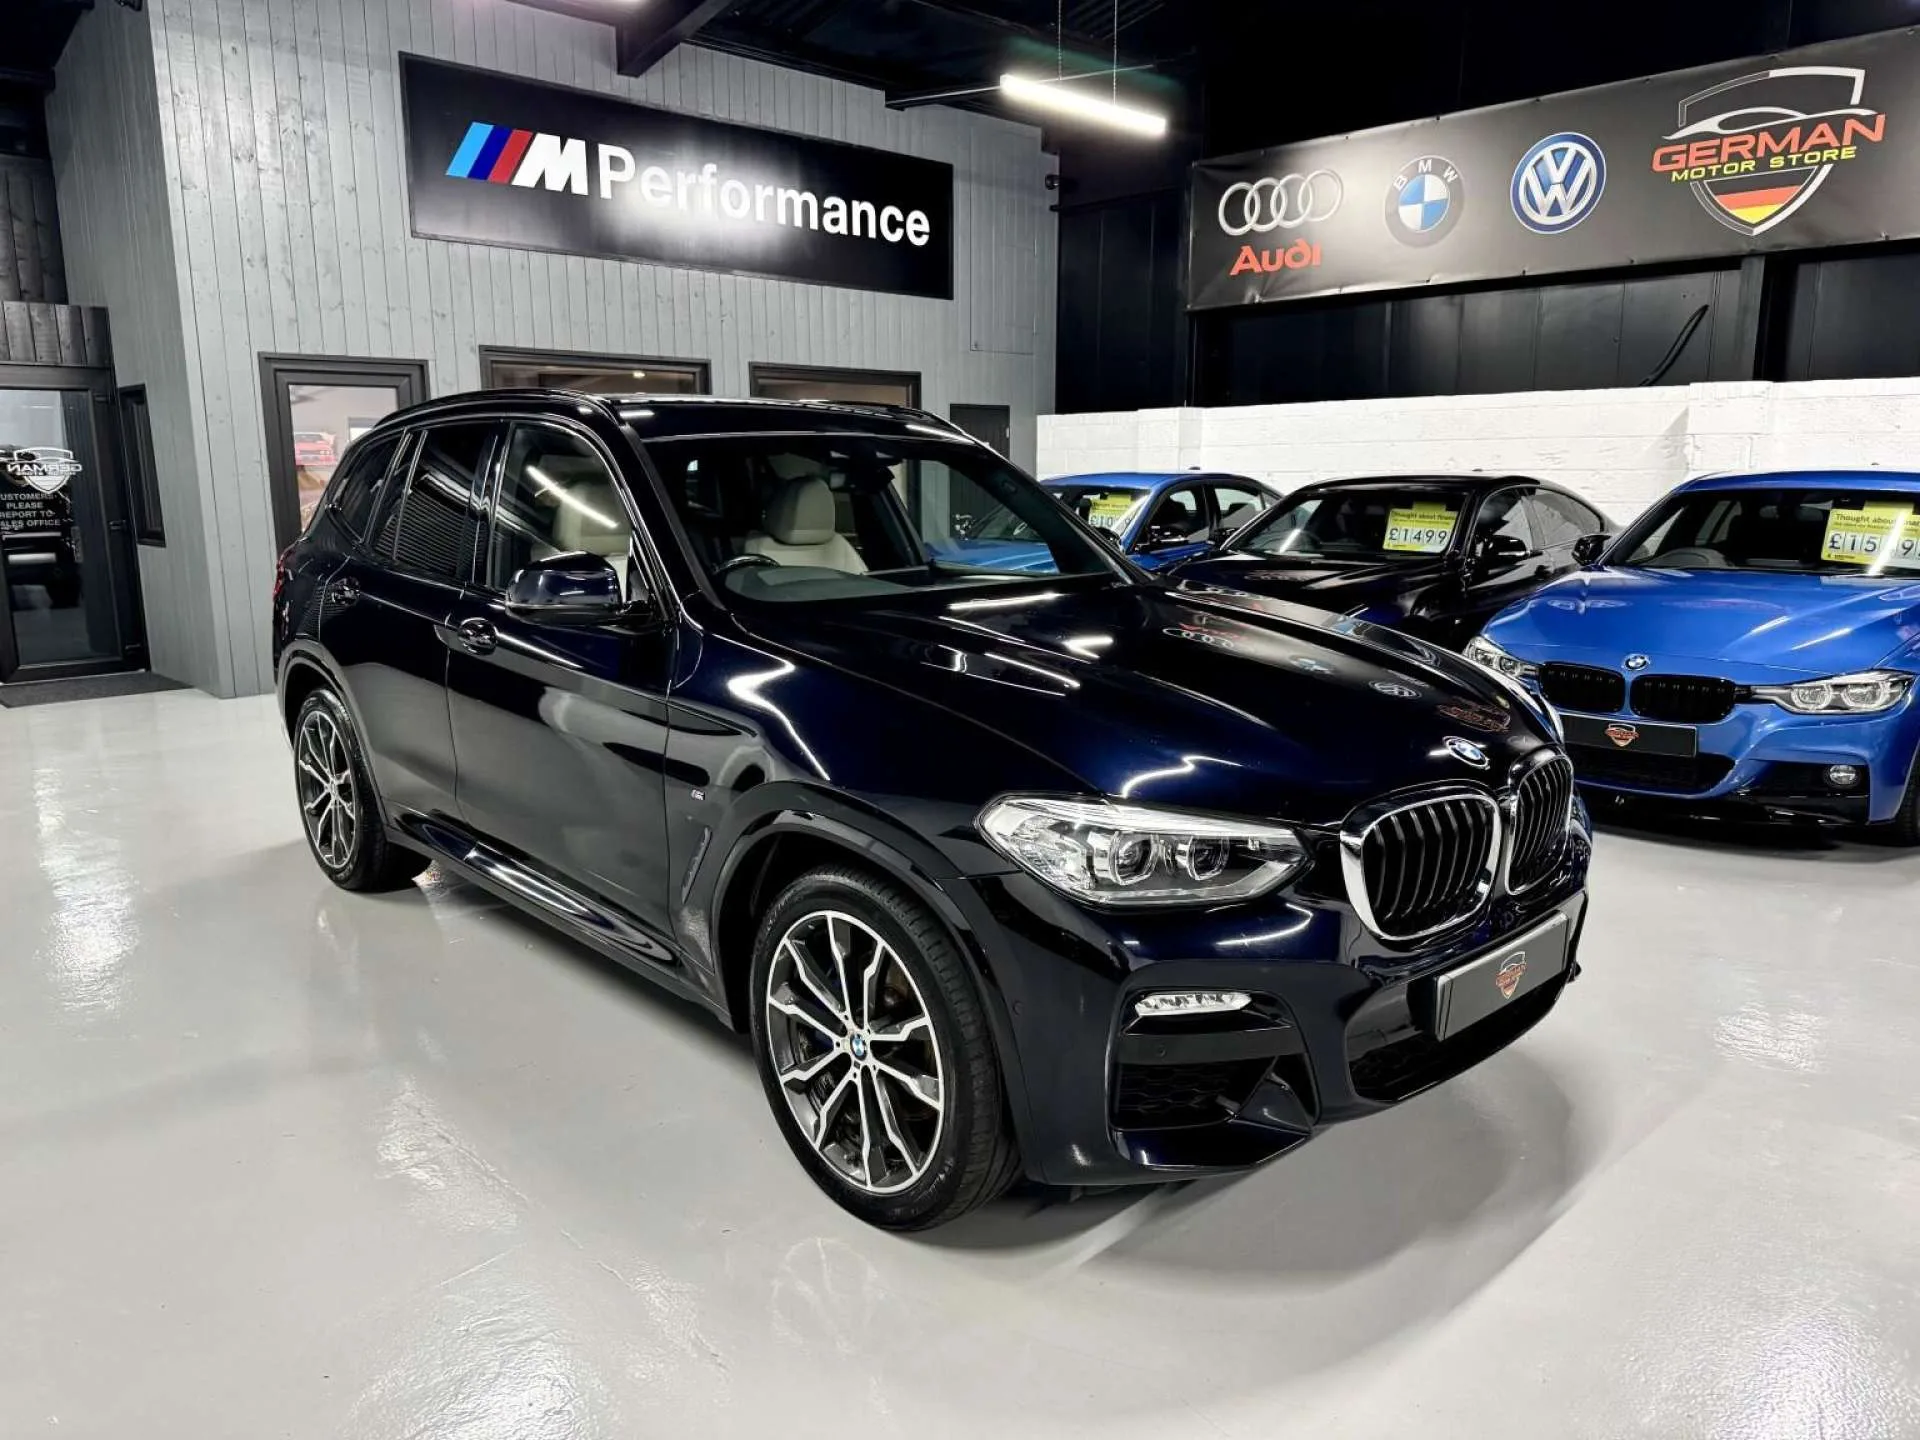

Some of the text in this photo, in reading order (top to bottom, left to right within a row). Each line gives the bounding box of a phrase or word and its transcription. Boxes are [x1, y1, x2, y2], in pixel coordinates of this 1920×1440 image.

[1652, 112, 1886, 174] GERMAN
[1393, 159, 1459, 191] BMW
[1671, 145, 1857, 183] MOTOR STORE
[598, 143, 931, 246] Performance
[1229, 238, 1321, 276] Audi
[0, 493, 54, 501] USTOMERS
[0, 519, 61, 528] ALES OFFICE
[40, 510, 54, 518] TO
[1836, 513, 1870, 523] Thought
[1872, 516, 1897, 524] abou
[1828, 533, 1920, 557] £159
